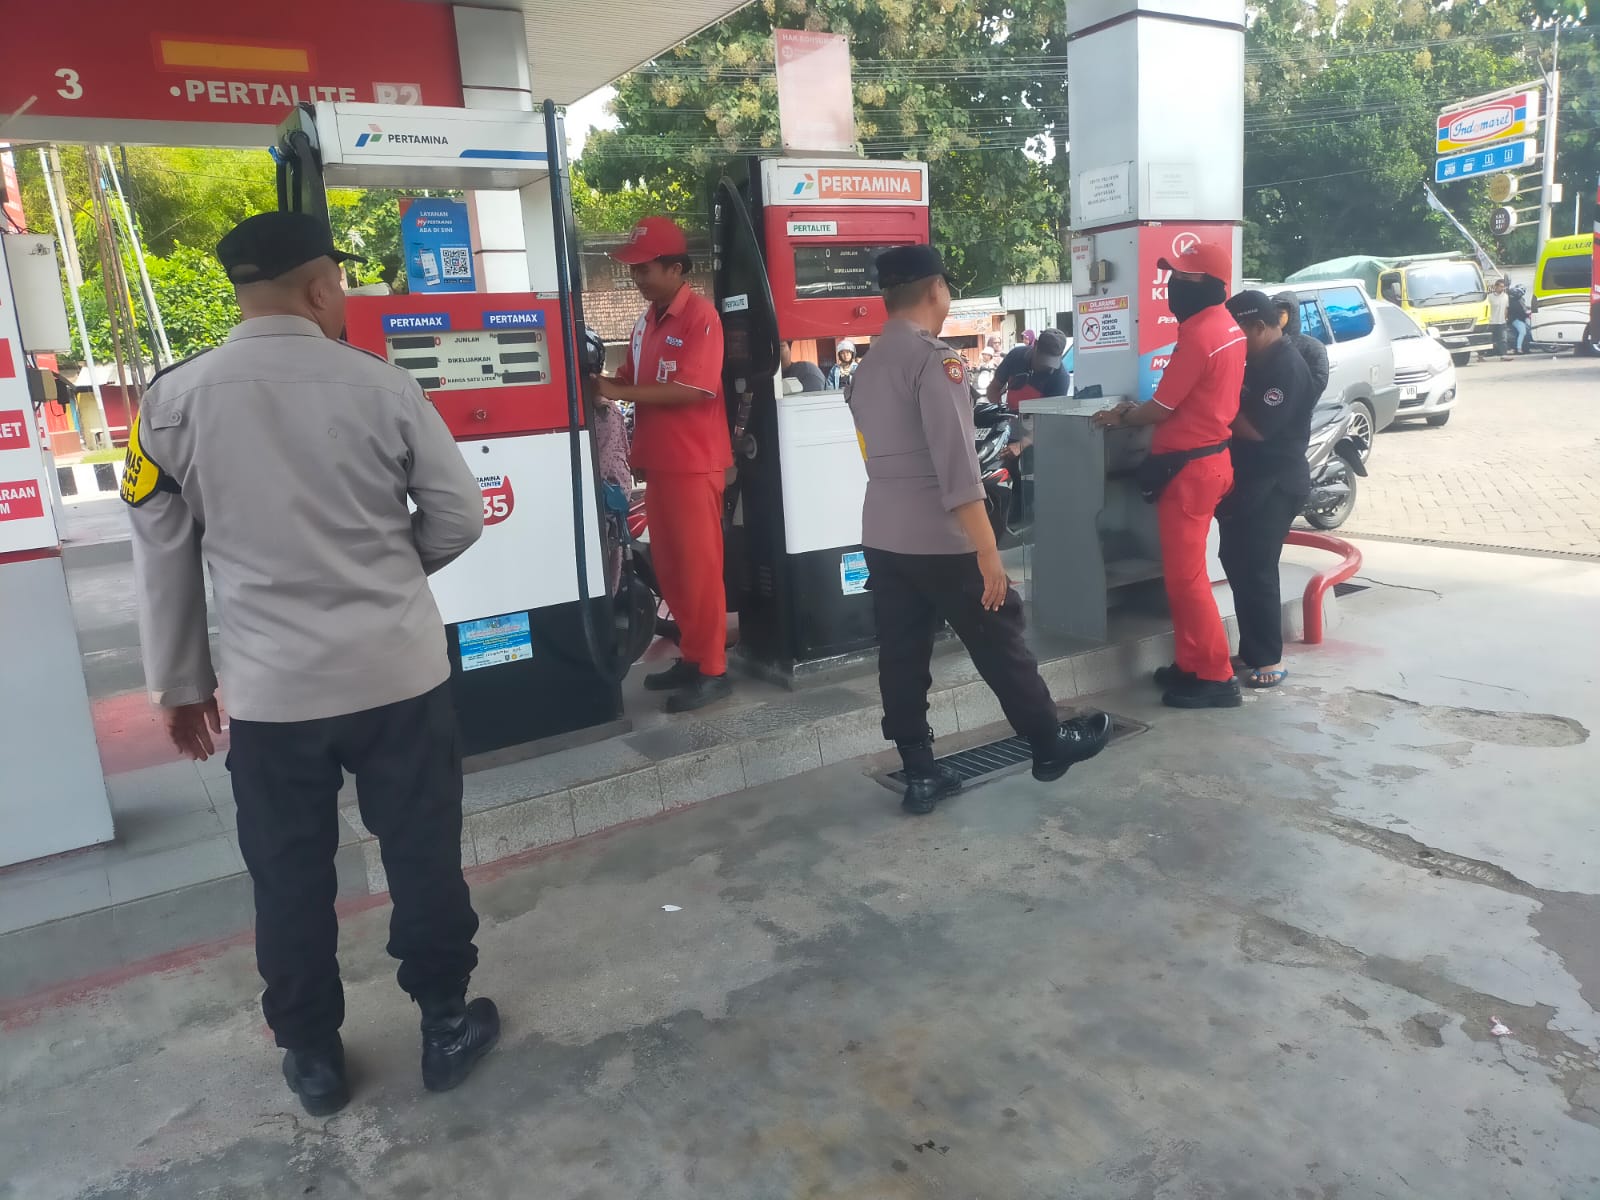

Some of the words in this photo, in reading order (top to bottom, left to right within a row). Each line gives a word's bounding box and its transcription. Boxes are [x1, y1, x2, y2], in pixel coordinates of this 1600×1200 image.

[54, 68, 83, 100] 3
[185, 79, 356, 106] PERTALITE
[376, 85, 419, 105] R2
[1453, 111, 1510, 137] Indomaret
[388, 132, 449, 146] PERTAMINA
[821, 175, 912, 194] PERTAMINA
[793, 224, 831, 233] PERTALITE
[390, 317, 442, 328] PERTAMAX
[489, 314, 538, 324] PERTAMAX
[0, 422, 22, 439] ET
[0, 486, 36, 501] RAAN
